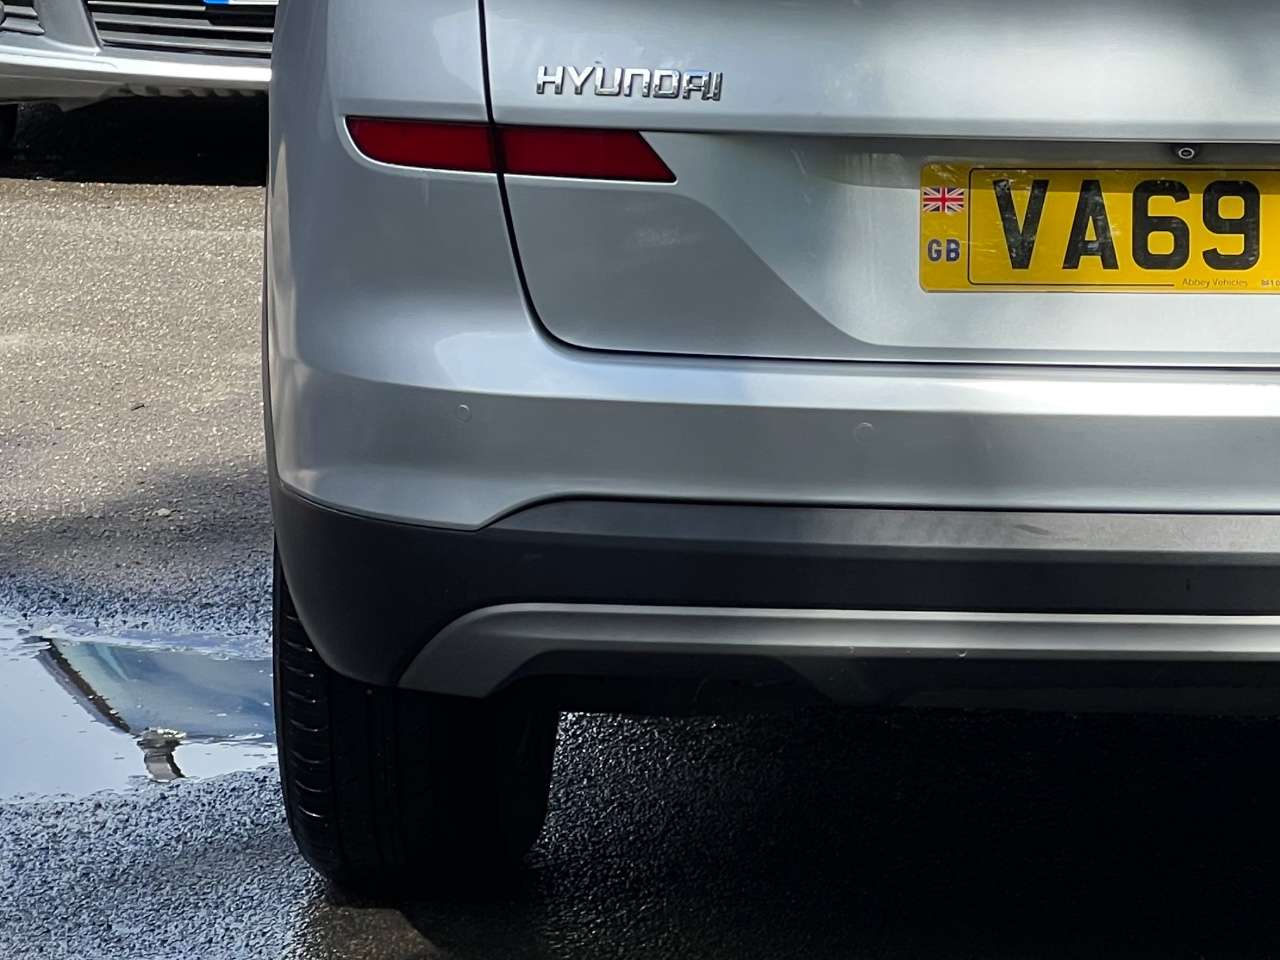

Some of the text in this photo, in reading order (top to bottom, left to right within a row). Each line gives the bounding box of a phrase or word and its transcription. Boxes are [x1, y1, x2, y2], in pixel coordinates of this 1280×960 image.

[535, 63, 725, 102] HYUNDAI
[993, 178, 1261, 271] VA69
[926, 239, 961, 263] GB
[1182, 278, 1210, 288] Abbey
